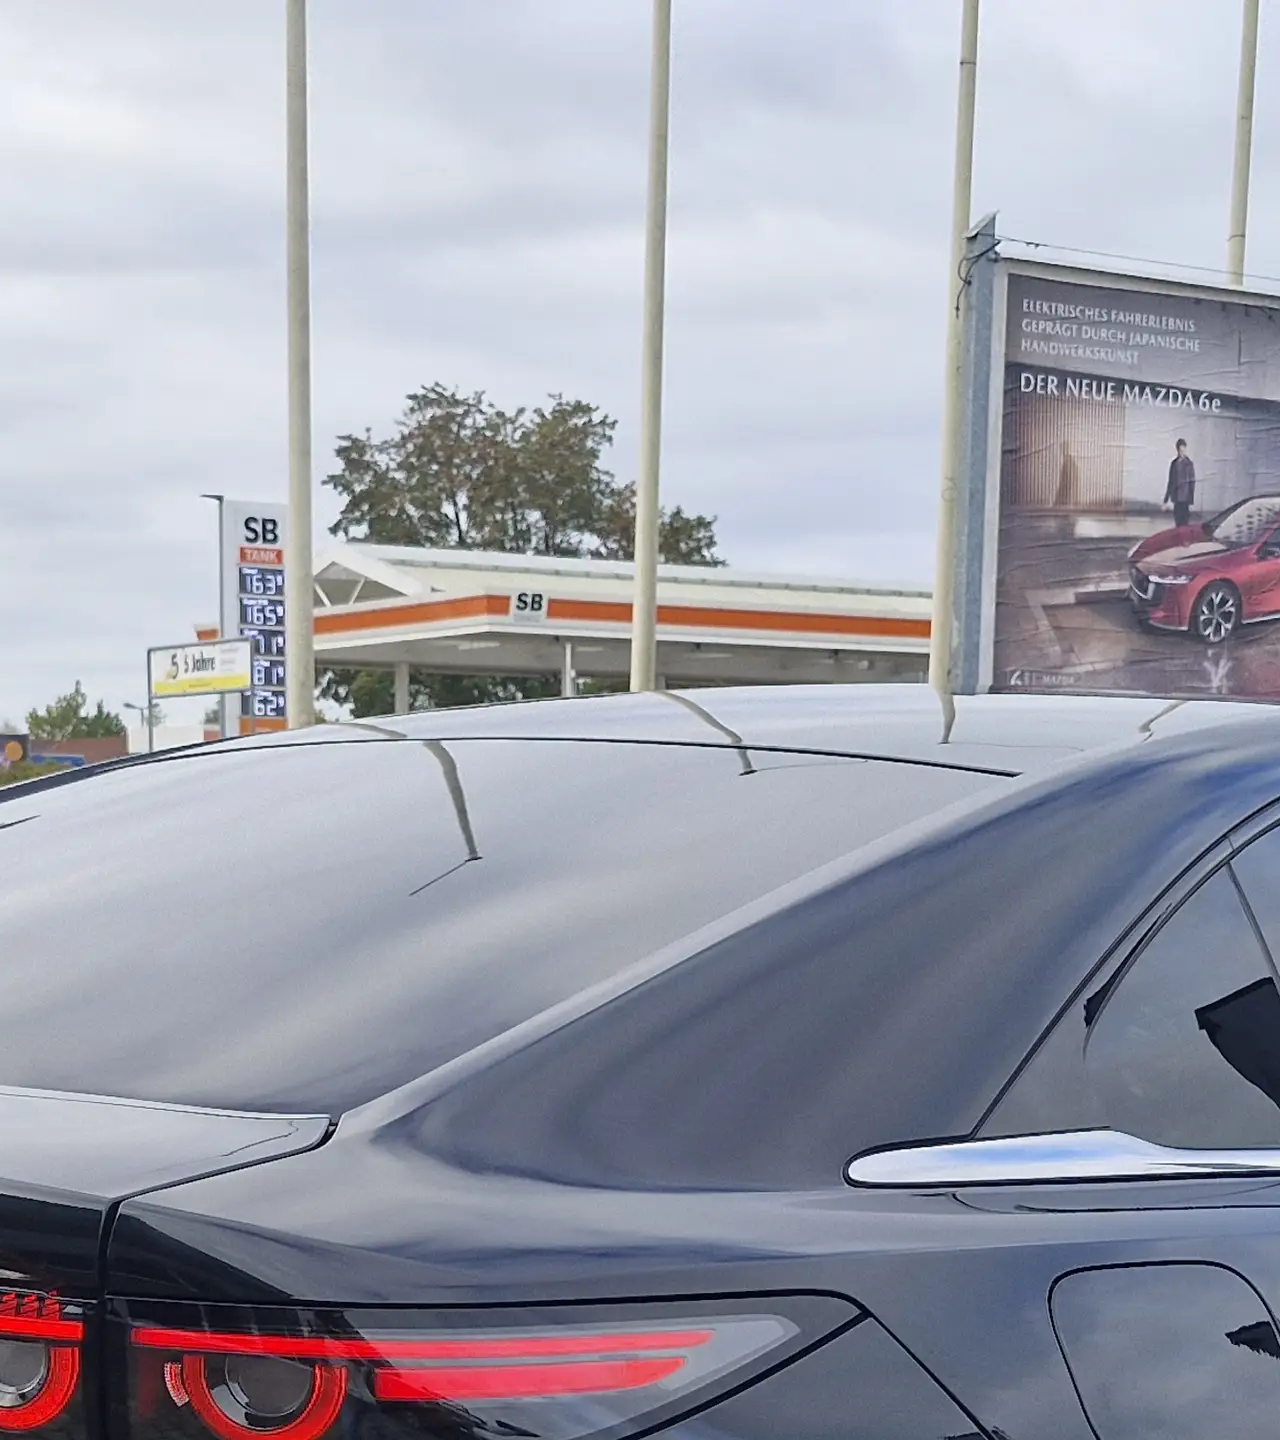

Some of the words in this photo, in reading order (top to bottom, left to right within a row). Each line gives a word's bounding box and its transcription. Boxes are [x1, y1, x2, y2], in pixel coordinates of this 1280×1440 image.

[1023, 299, 1108, 322] ELEKTRISCHES
[1111, 310, 1195, 332] FAHRERLEBNIS
[1022, 317, 1079, 337] GEPRÄGT
[1082, 326, 1126, 345] DURCH
[1129, 333, 1200, 352] JAPANISCHE
[1021, 339, 1140, 364] HANDWERKSKUNST
[1020, 373, 1059, 396] DER
[1066, 378, 1116, 401] NEUE
[244, 517, 278, 544] SB
[245, 549, 278, 563] TANK
[516, 592, 543, 611] SB
[191, 650, 216, 673] Jahre
